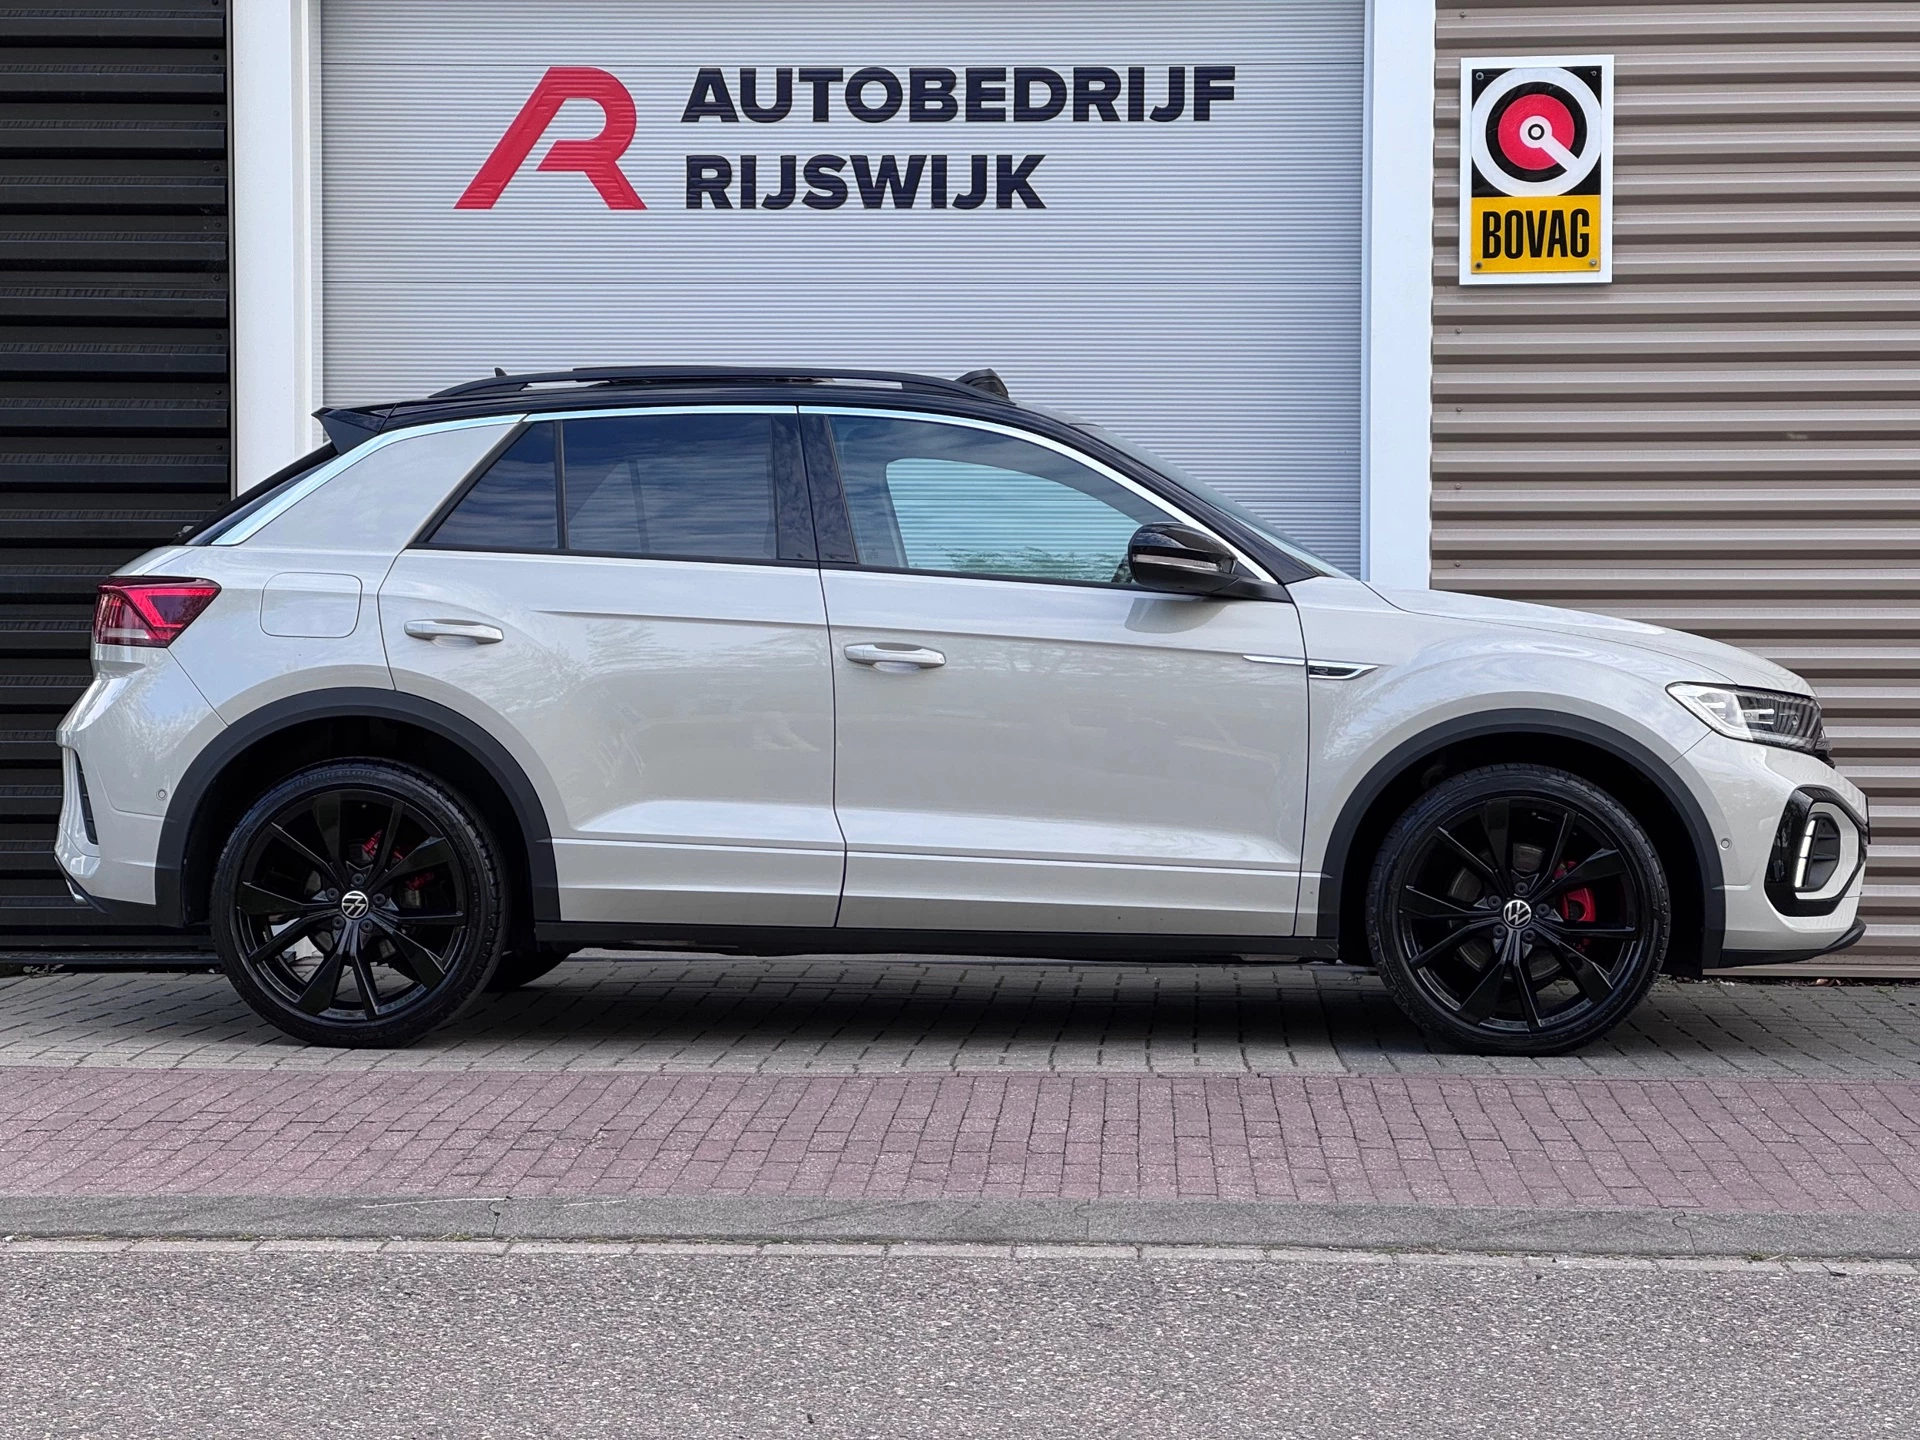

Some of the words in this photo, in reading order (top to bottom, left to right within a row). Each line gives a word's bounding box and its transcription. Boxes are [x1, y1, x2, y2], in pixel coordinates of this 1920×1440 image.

[681, 66, 1236, 123] AUTOBEDRIJF
[686, 155, 1046, 210] RIJSWIJK
[1482, 208, 1589, 259] BOVAG
